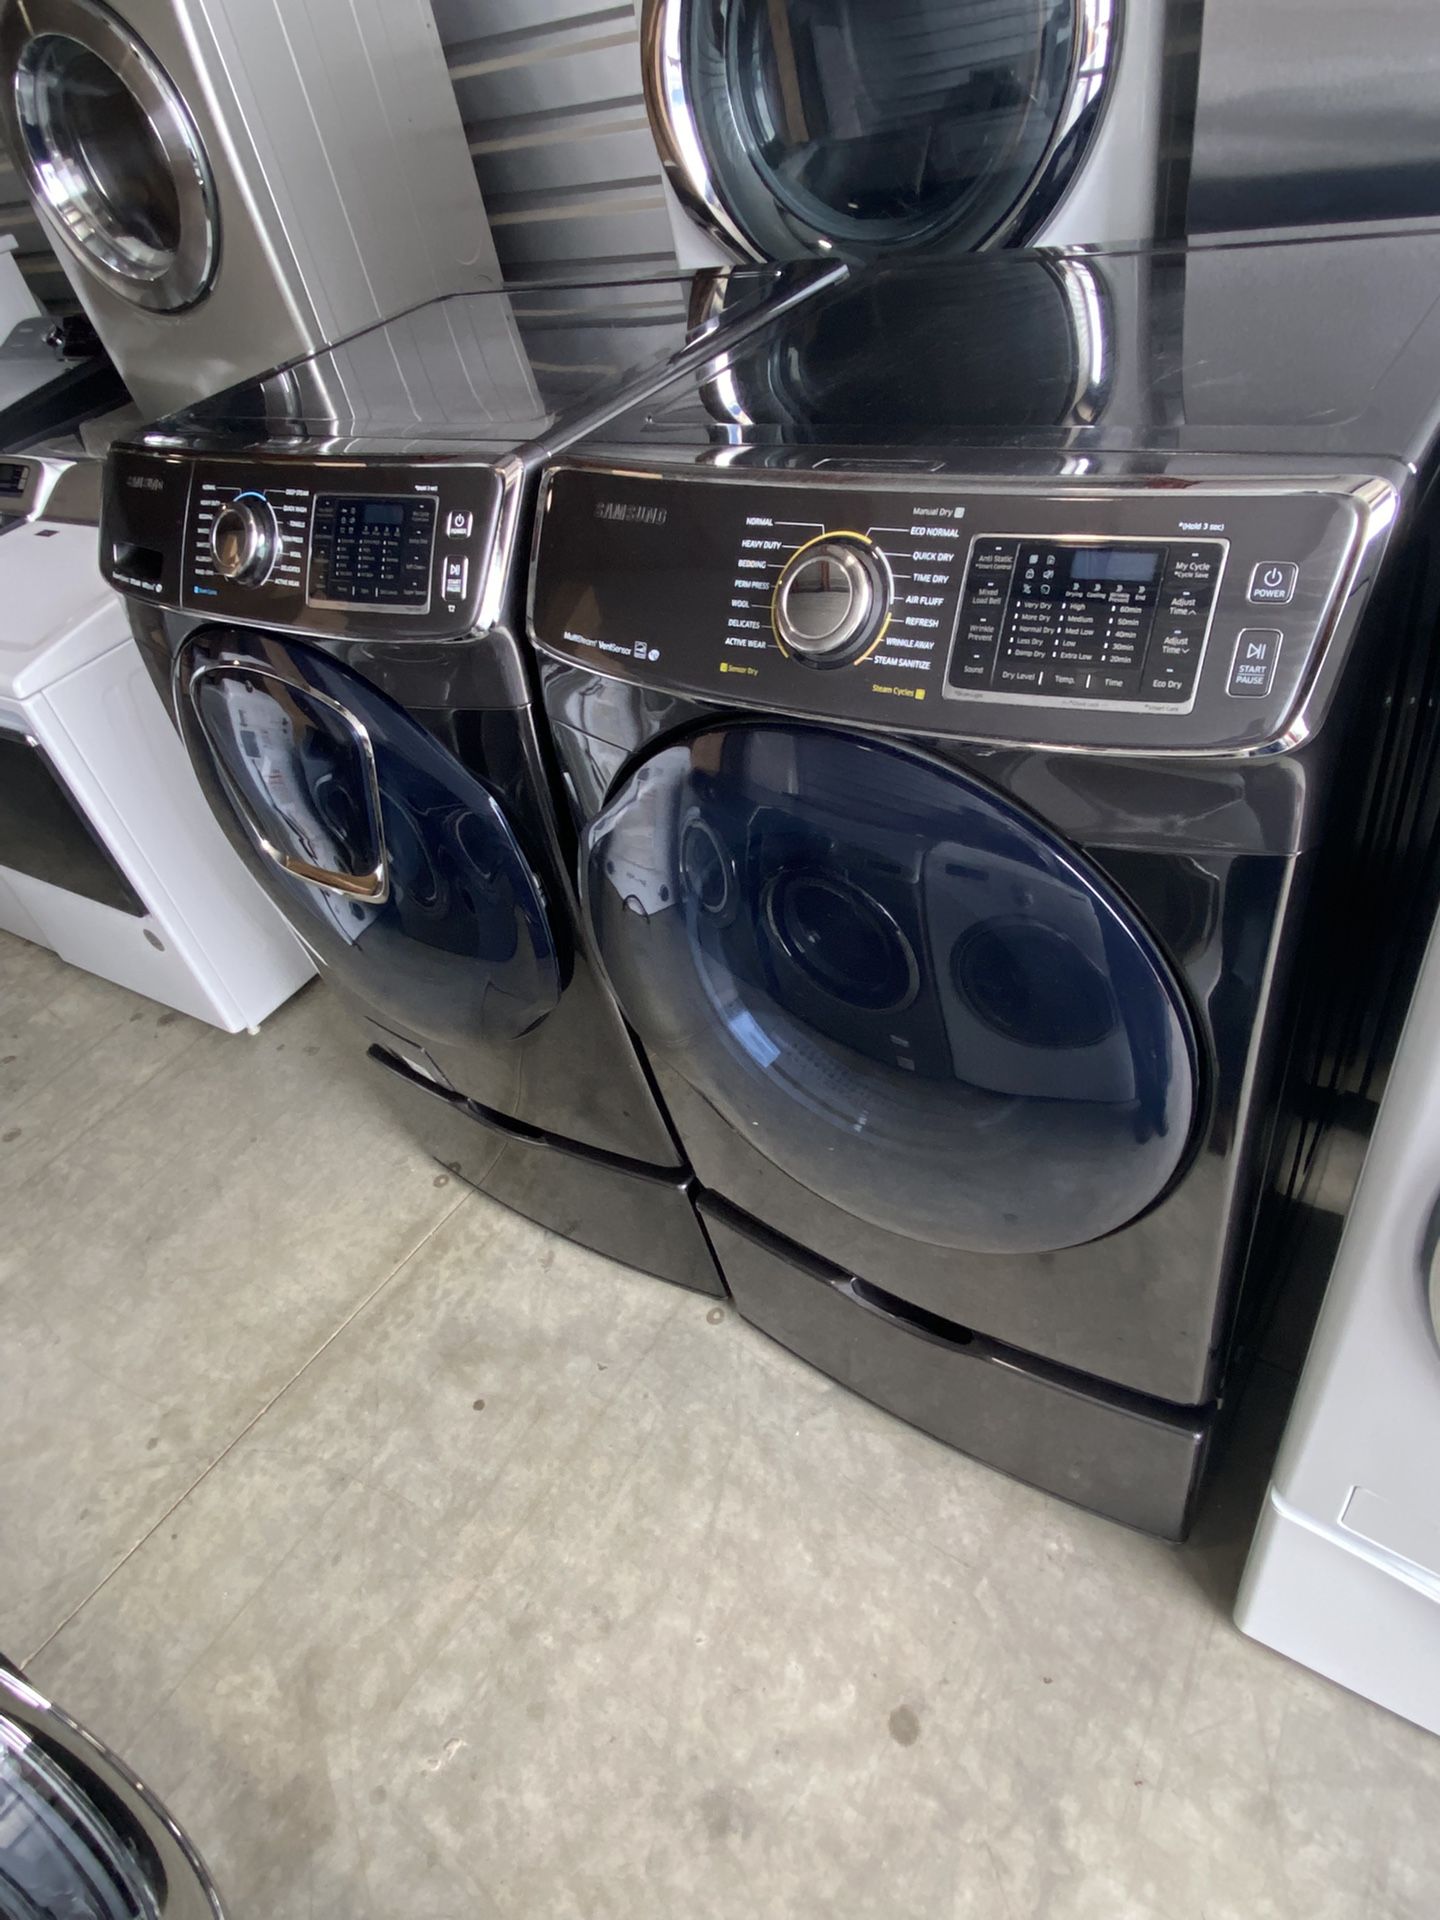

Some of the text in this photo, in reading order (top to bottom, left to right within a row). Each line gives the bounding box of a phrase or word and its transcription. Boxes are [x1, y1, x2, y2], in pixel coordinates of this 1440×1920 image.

[595, 503, 667, 525] SAMSUNG
[913, 507, 953, 517] Manual Dry
[746, 517, 773, 526] NORMAL
[910, 526, 959, 538] ECO NORMAL
[741, 540, 782, 550] HEAVY DUTY
[912, 551, 954, 562] QUICK DRY
[738, 559, 766, 569] BEDDING
[1175, 561, 1211, 571] My Cycle
[913, 573, 949, 584] TIME DRY
[734, 580, 770, 590] PERM PRESS
[1253, 588, 1286, 599] POWER
[731, 599, 749, 608] WOOL
[905, 597, 944, 607] AIR FLUFF
[1024, 602, 1052, 610] Very Dry
[1069, 603, 1086, 611] High
[1171, 598, 1196, 607] Adjust
[1169, 607, 1188, 616] Time
[905, 617, 939, 628] REFRESH
[1039, 613, 1051, 622] Dry
[1067, 615, 1094, 623] Medium
[728, 618, 760, 629] DELICATES
[969, 625, 995, 633] Wrinkle
[1019, 625, 1055, 635] Normal Dry
[1080, 628, 1094, 636] Low
[968, 633, 992, 641] Prevent
[1031, 638, 1044, 646] Dry
[1164, 636, 1188, 646] Adjust
[725, 637, 767, 649] ACTIVE WEAR
[886, 636, 935, 650] WRINKLE AWAY
[1033, 650, 1046, 658] Dry
[1162, 645, 1181, 654] Time
[1060, 651, 1093, 660] Extra Low
[874, 655, 931, 670] STEAM SANITIZE
[747, 667, 759, 676] Dry
[964, 665, 984, 674] Sound
[1239, 664, 1267, 674] START
[1002, 671, 1036, 681] Dry Level
[1236, 675, 1264, 685] PAUSE
[1105, 678, 1124, 687] Time
[1152, 679, 1183, 690] Eco Dry
[872, 684, 914, 697] Steam Cycles
